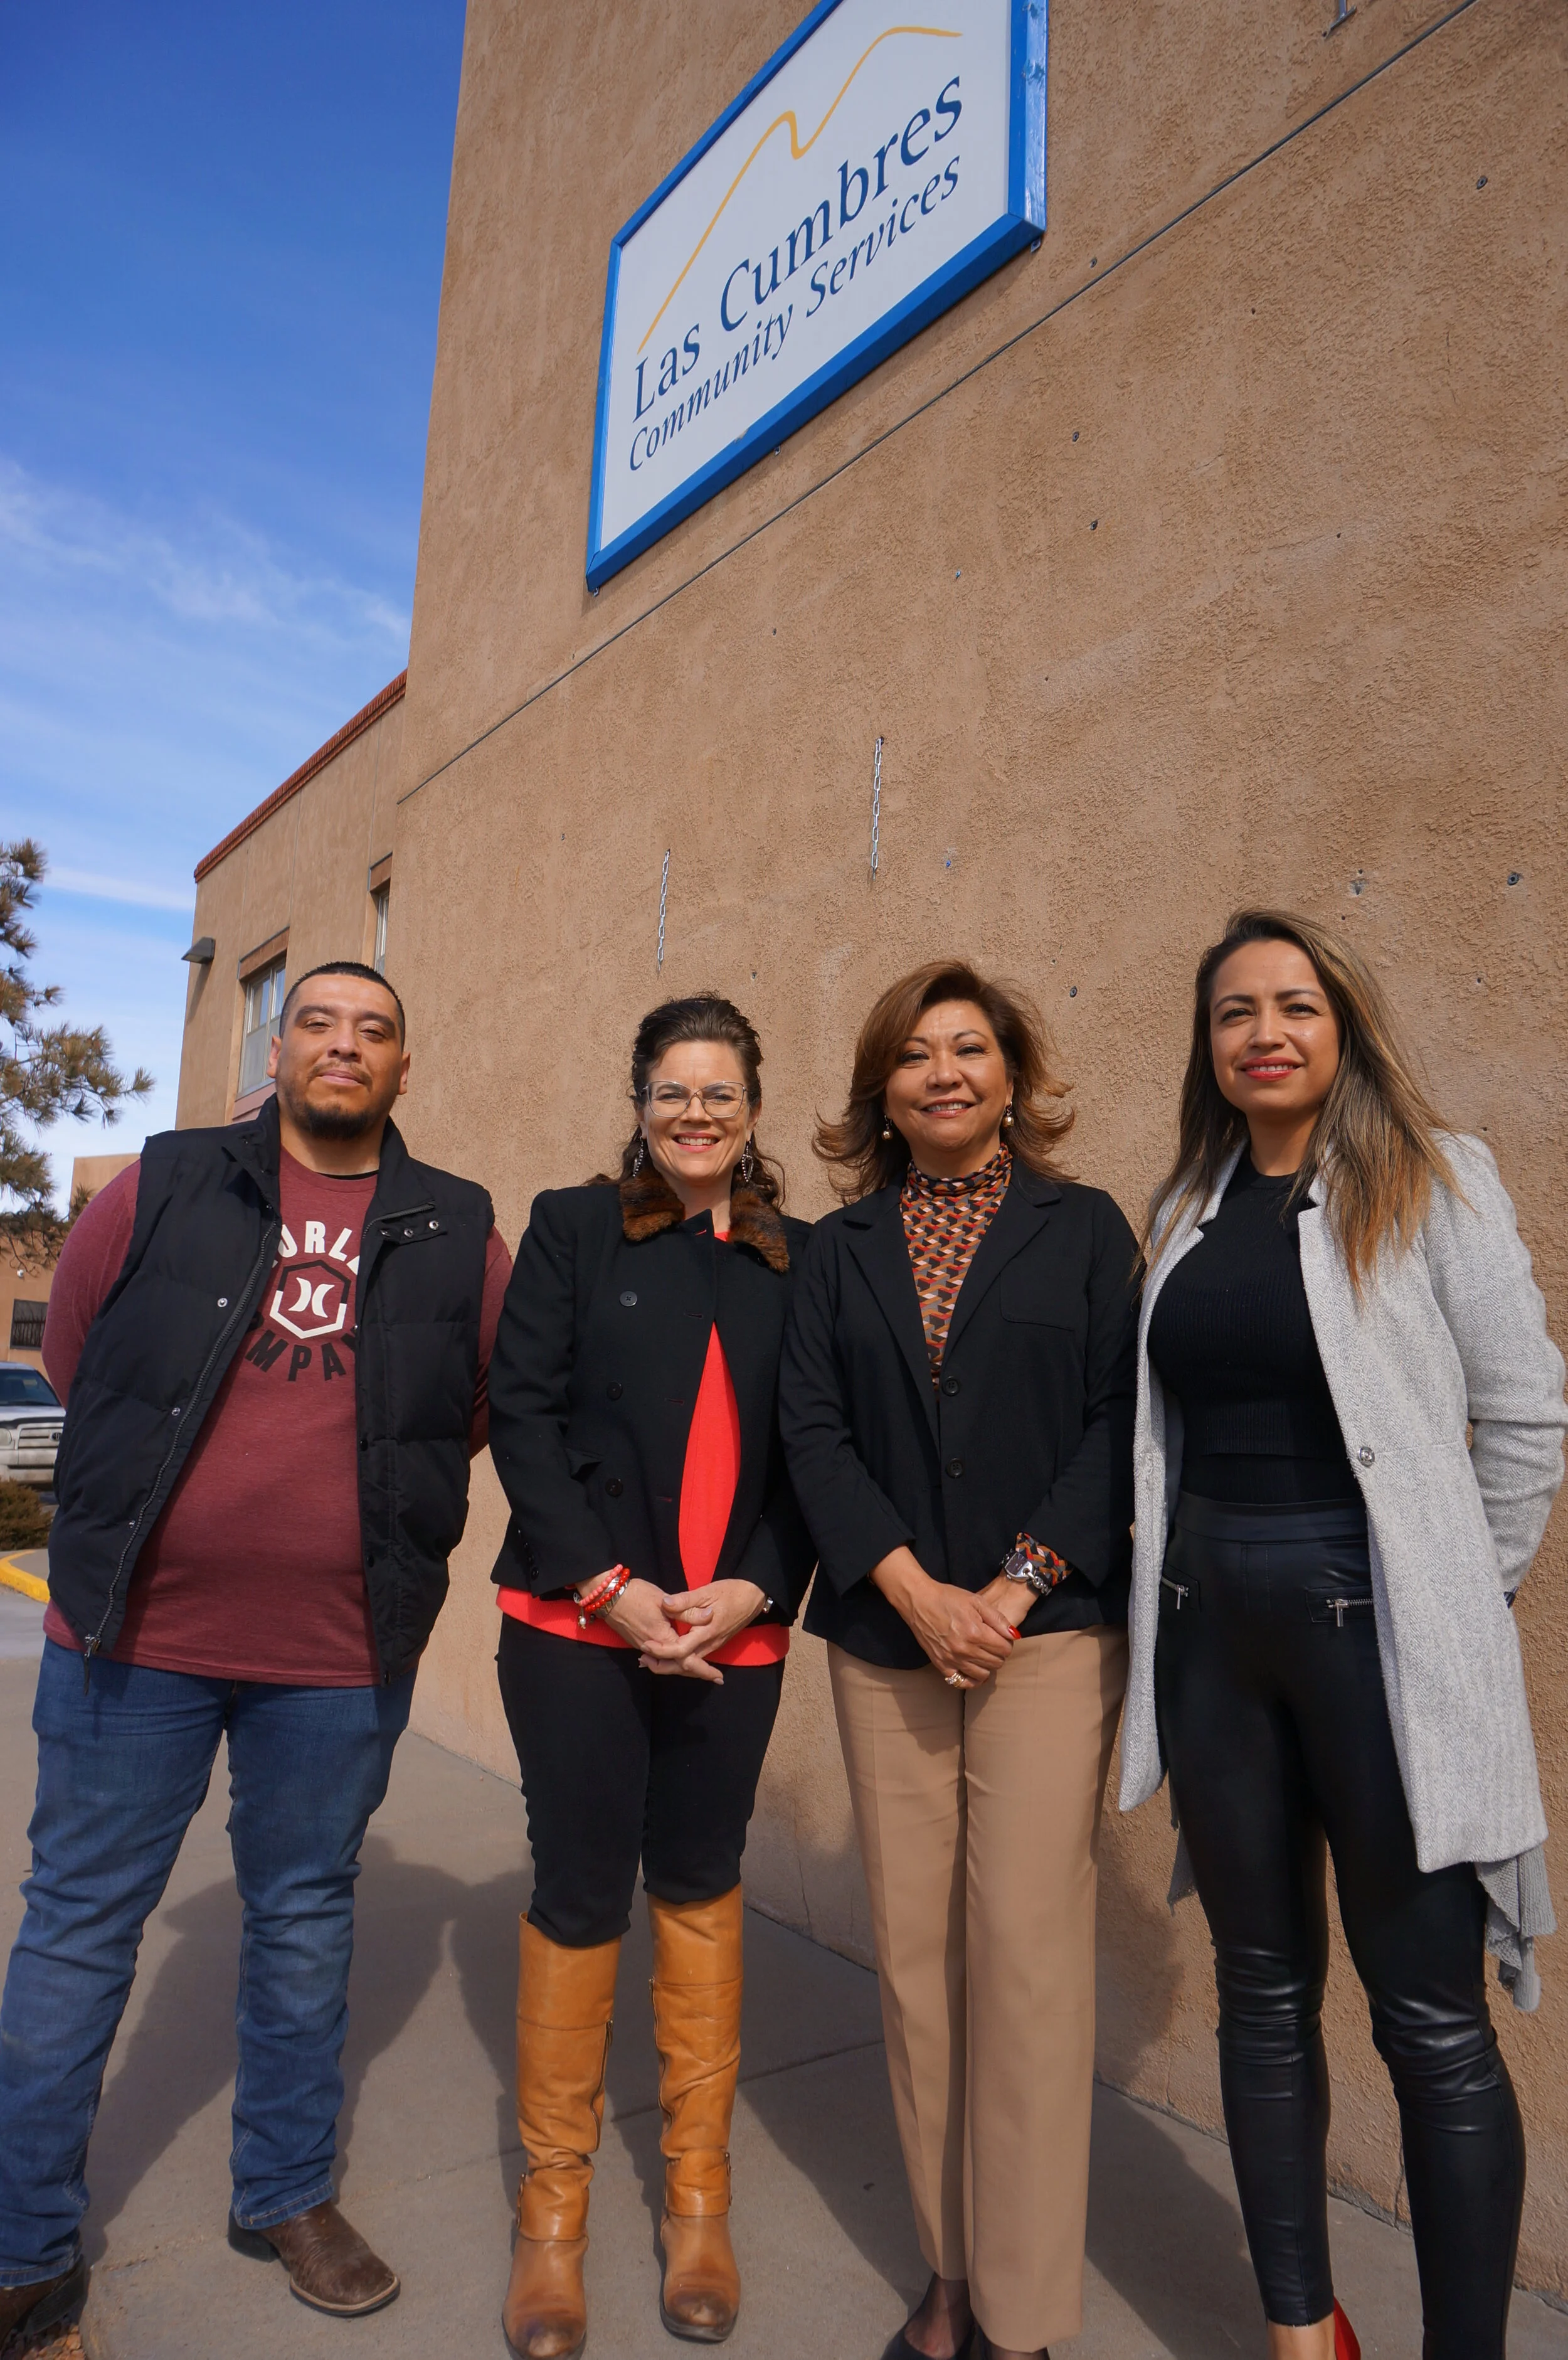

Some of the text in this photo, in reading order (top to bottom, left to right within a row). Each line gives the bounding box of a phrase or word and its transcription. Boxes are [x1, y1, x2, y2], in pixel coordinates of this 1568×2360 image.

[630, 156, 960, 471] Community Services
[633, 76, 962, 423] Las Cumbres
[272, 1221, 359, 1275] URL
